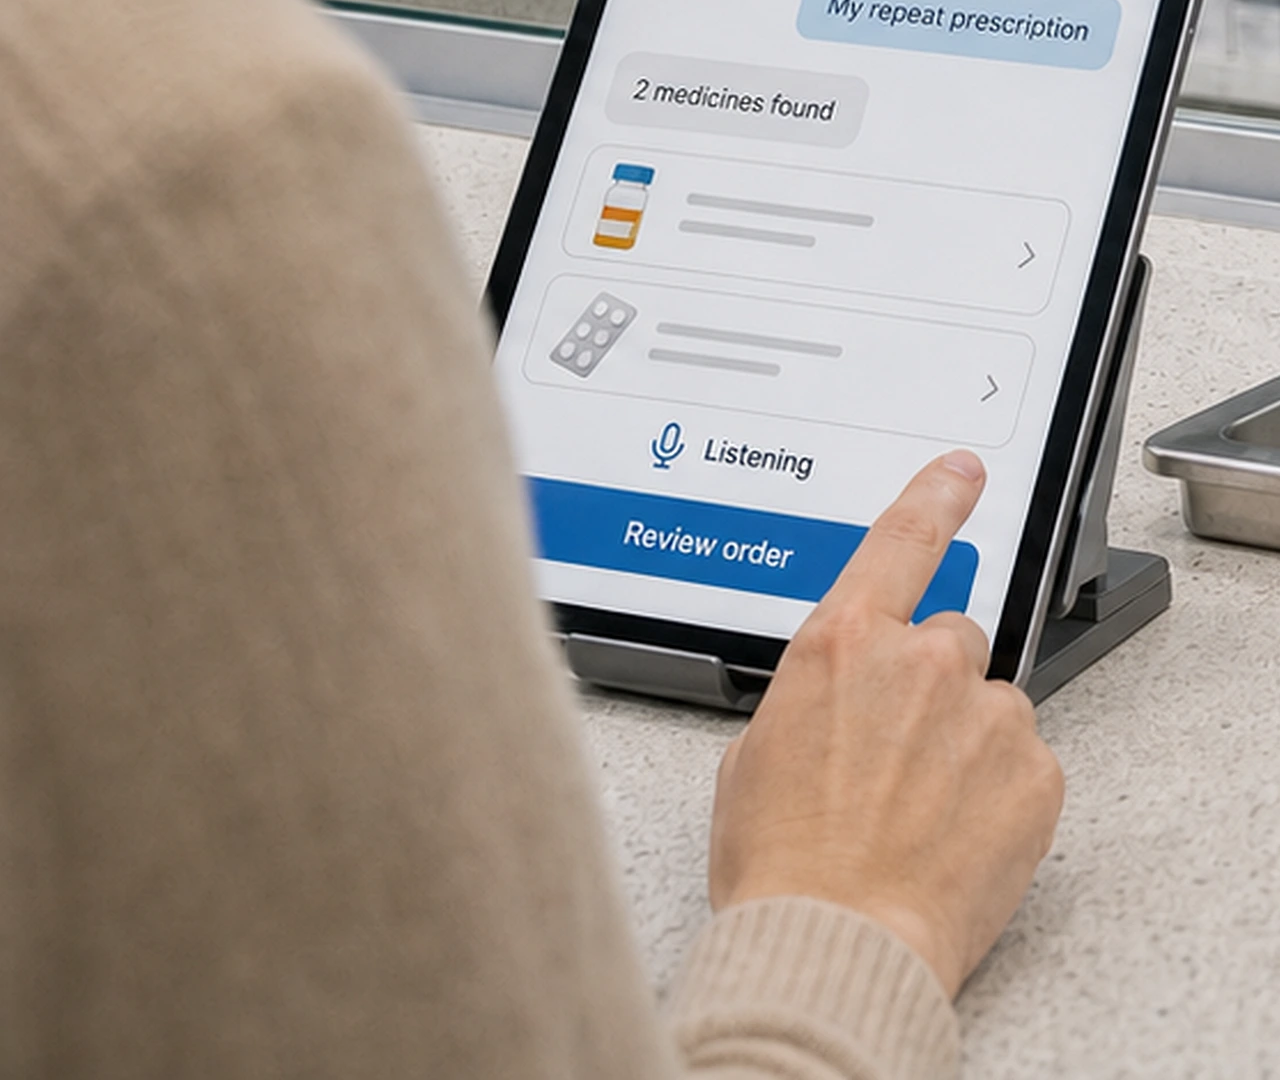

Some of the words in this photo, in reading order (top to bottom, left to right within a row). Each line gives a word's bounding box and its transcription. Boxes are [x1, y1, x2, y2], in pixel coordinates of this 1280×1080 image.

[868, 3, 945, 28] repeat
[949, 12, 1089, 41] prescription
[632, 78, 650, 102] 2
[653, 82, 765, 114] medicines
[769, 93, 836, 121] found
[703, 439, 814, 481] Listening
[623, 521, 718, 557] Review
[722, 539, 794, 569] order
